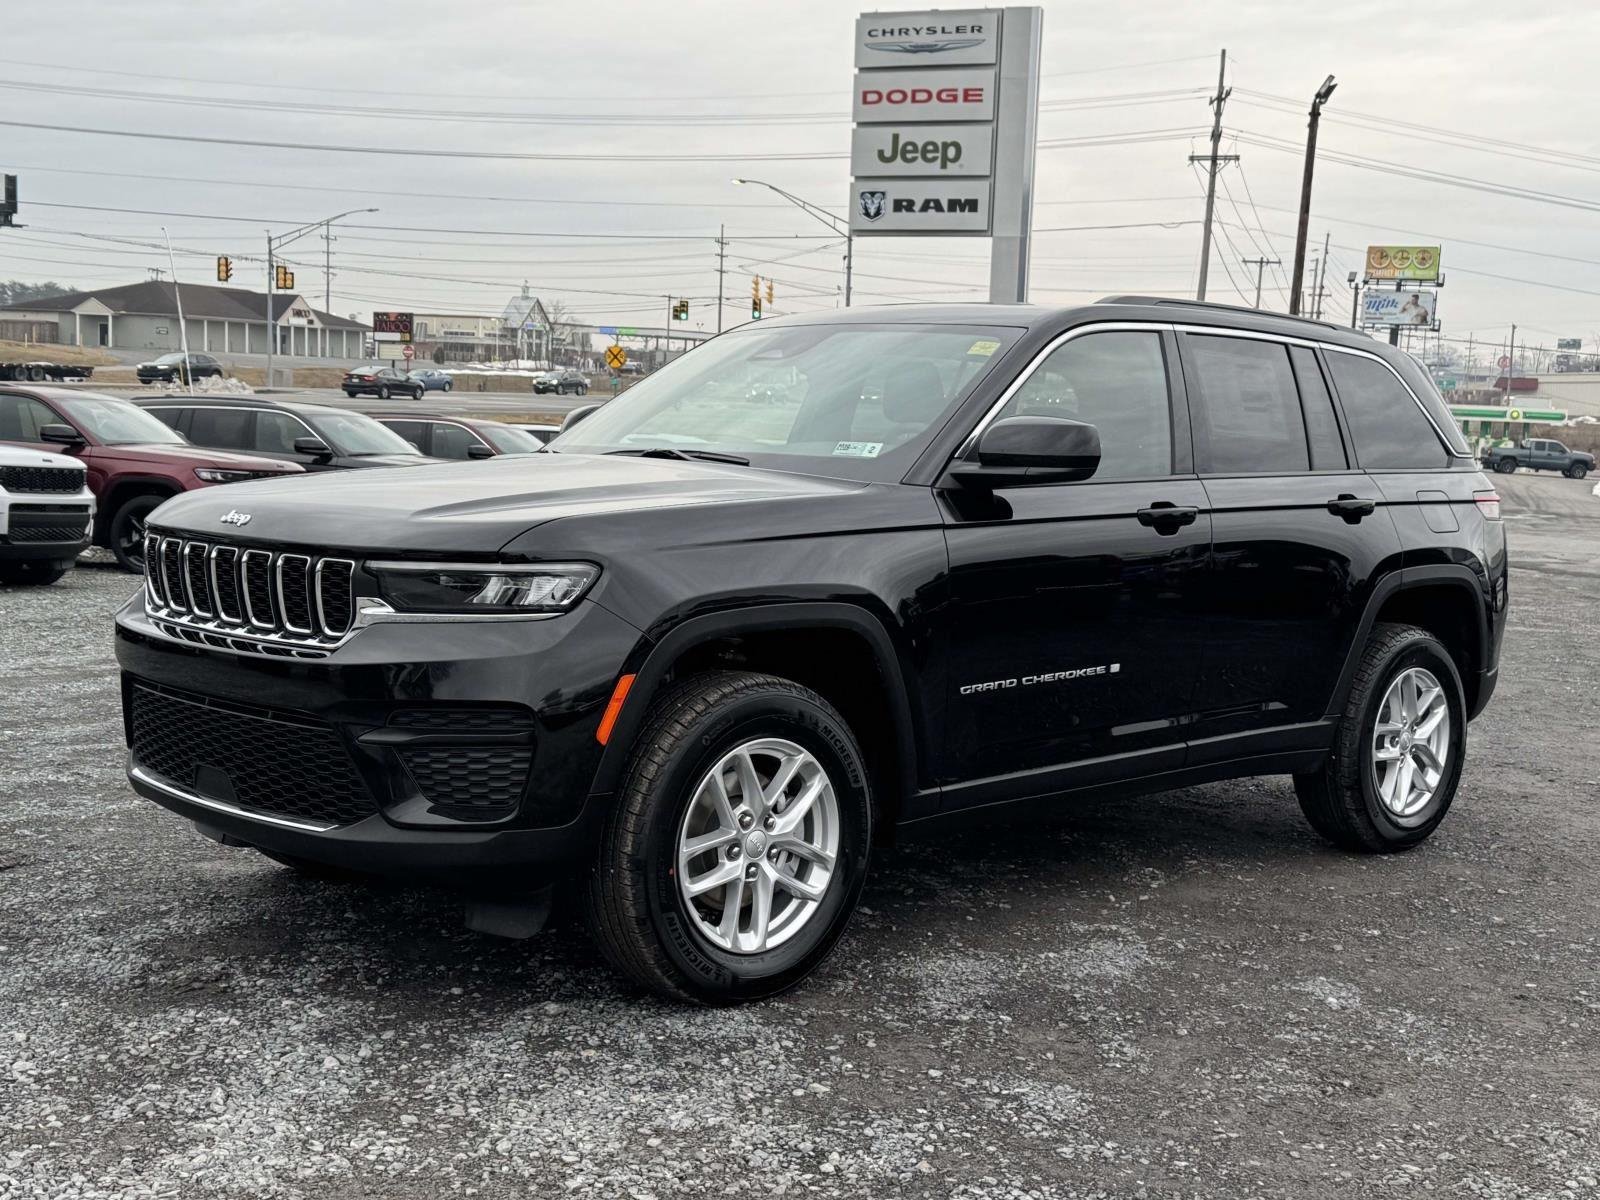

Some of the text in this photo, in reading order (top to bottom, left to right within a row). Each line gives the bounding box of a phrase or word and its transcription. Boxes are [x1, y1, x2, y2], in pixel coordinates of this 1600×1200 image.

[867, 25, 983, 38] CHRYSLER
[862, 88, 984, 105] DODGE
[877, 133, 962, 169] Jeep
[892, 198, 979, 213] RAM
[220, 509, 251, 527] Jeep
[960, 665, 1106, 695] GRAND CHEROKEE
[820, 724, 861, 786] MICHELIN
[665, 915, 714, 977] MICHELIN
